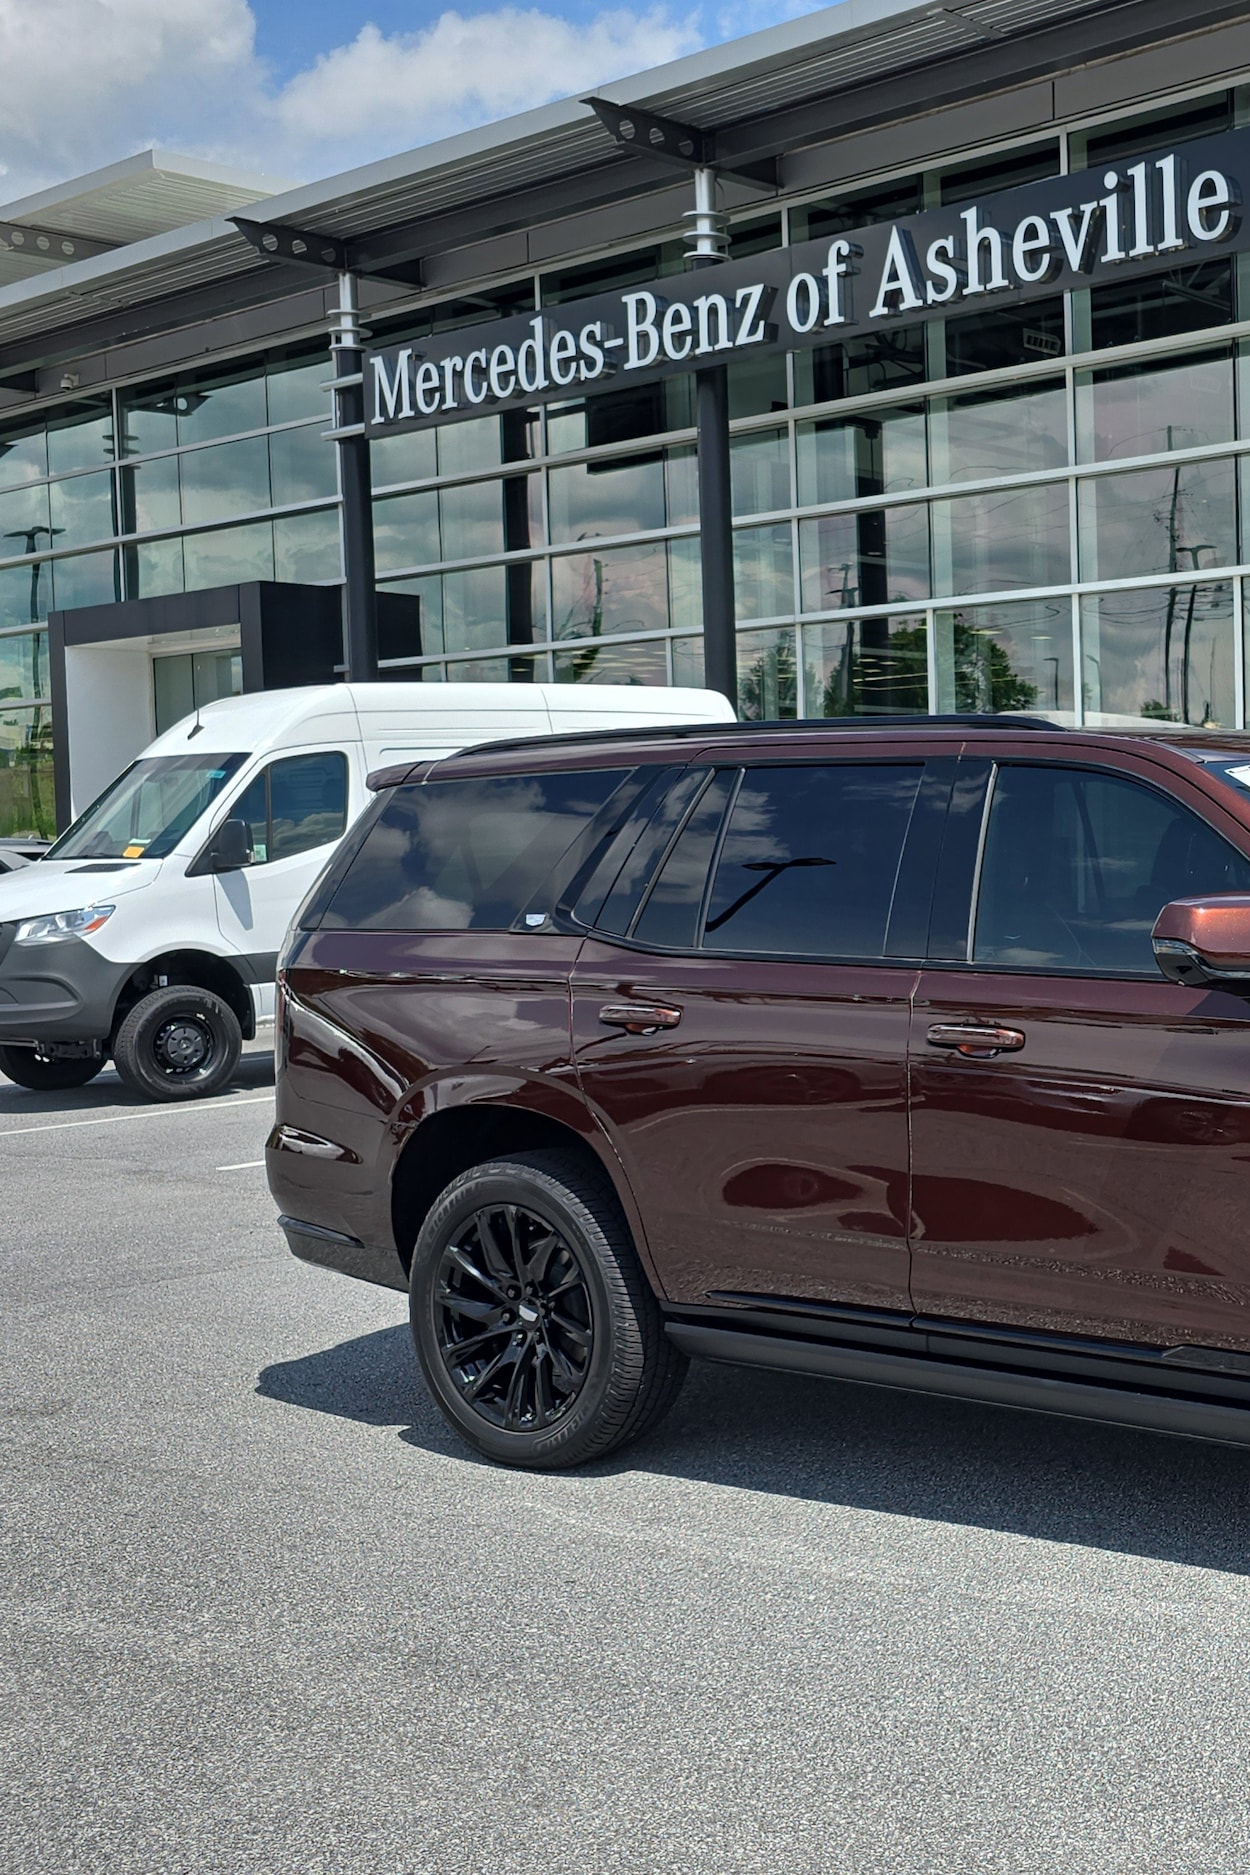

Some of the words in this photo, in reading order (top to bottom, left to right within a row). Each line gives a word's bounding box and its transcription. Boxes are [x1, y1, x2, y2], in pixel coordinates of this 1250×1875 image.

[369, 290, 766, 425] Mercedes-Benz
[786, 239, 850, 334] of
[868, 152, 1231, 319] Asheville
